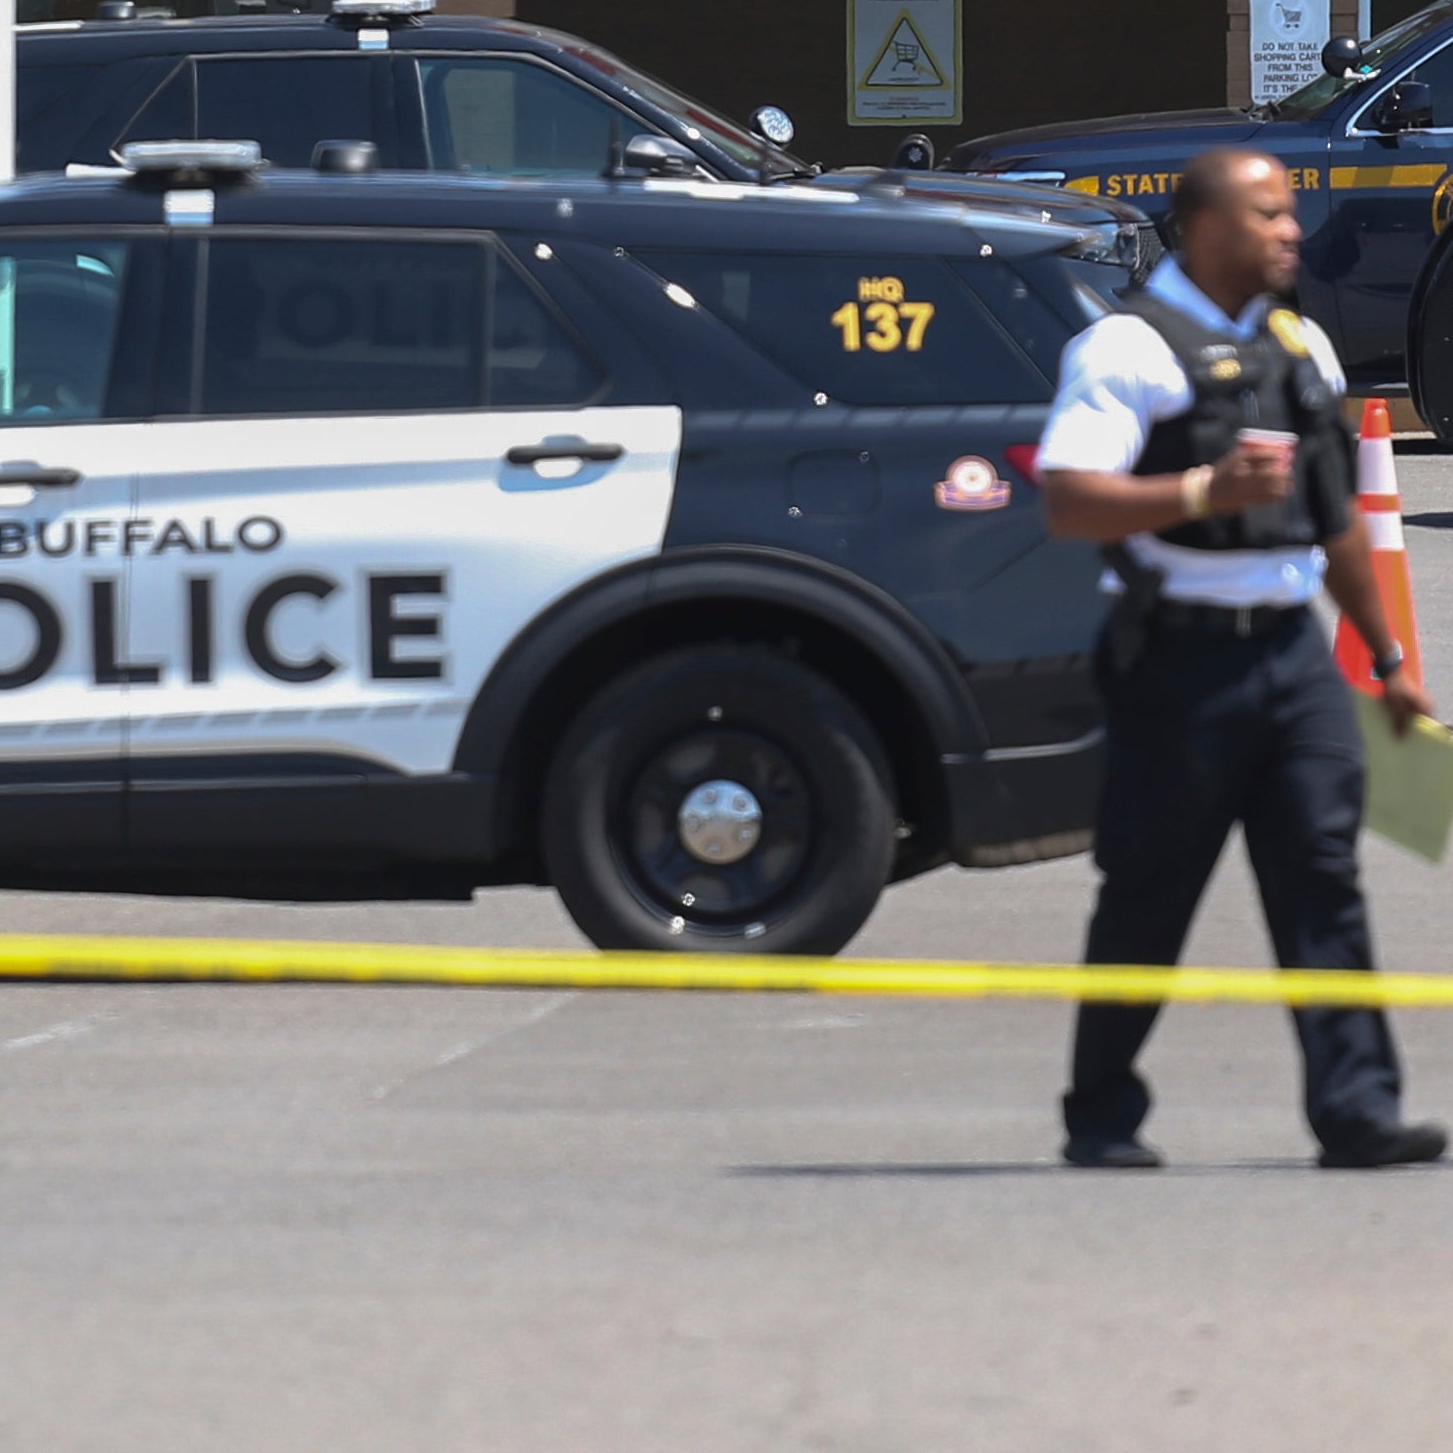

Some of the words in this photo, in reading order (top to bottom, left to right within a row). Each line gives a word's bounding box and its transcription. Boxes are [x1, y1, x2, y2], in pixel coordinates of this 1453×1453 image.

[1262, 43, 1275, 51] DO
[1278, 43, 1295, 51] NOT
[1298, 43, 1317, 51] TAKE
[1254, 53, 1296, 61] SHOPPING
[1268, 63, 1292, 72] FROM
[1295, 63, 1313, 71] THIS
[1263, 74, 1299, 82] PARKING
[858, 276, 905, 303] HQ
[831, 301, 936, 352] 137
